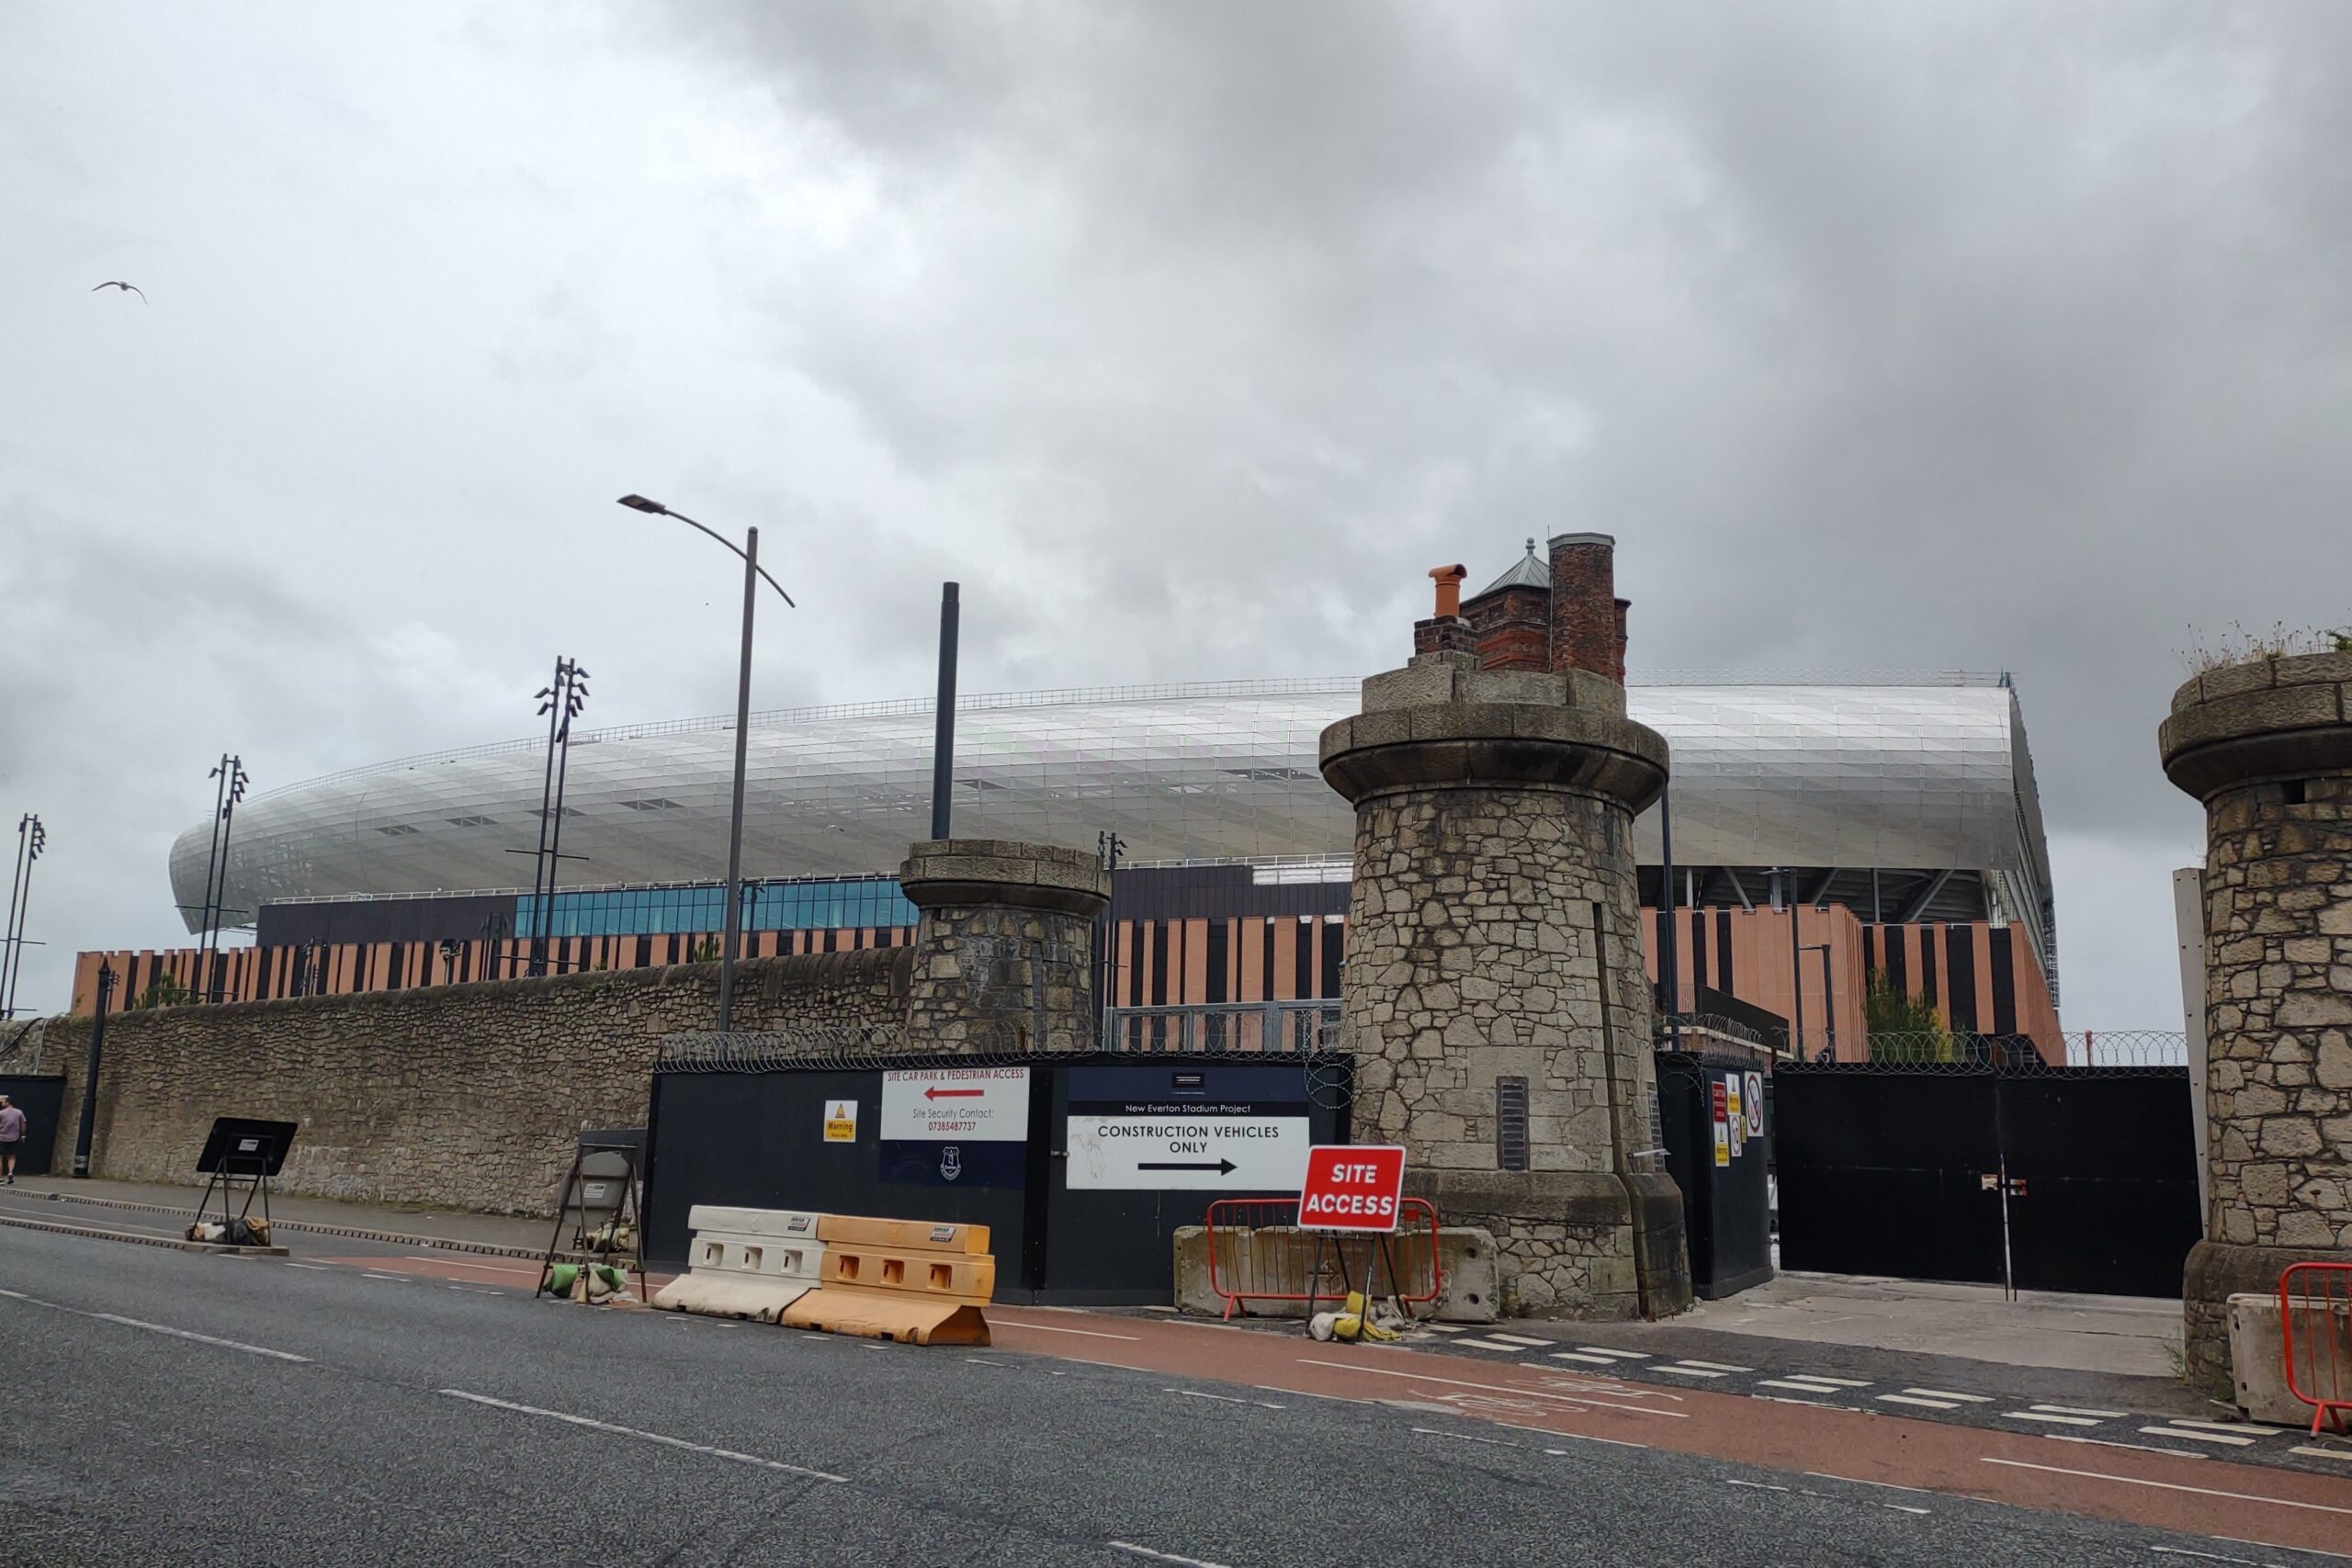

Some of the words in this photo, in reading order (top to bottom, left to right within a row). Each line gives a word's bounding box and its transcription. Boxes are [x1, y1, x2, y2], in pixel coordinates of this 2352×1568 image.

[888, 1072, 901, 1082] SITE
[902, 1071, 919, 1082] CAR
[920, 1071, 938, 1081] PARK
[940, 1071, 945, 1081] &
[947, 1069, 991, 1080] PEDESTRIAN
[993, 1068, 1024, 1079] ACCESS
[912, 1108, 926, 1119] Site
[928, 1108, 957, 1120] Security
[1125, 1104, 1145, 1112] New
[1148, 1104, 1180, 1112] Everton
[1182, 1104, 1217, 1112] Stadium
[1220, 1104, 1250, 1114] Project
[828, 1122, 854, 1133] Warning
[1098, 1125, 1208, 1138] CONSTRUCTION
[1214, 1126, 1279, 1138] VEHICLES
[1170, 1141, 1207, 1153] ONLY
[1330, 1163, 1377, 1184] SITE
[1306, 1193, 1394, 1216] ACCESS
